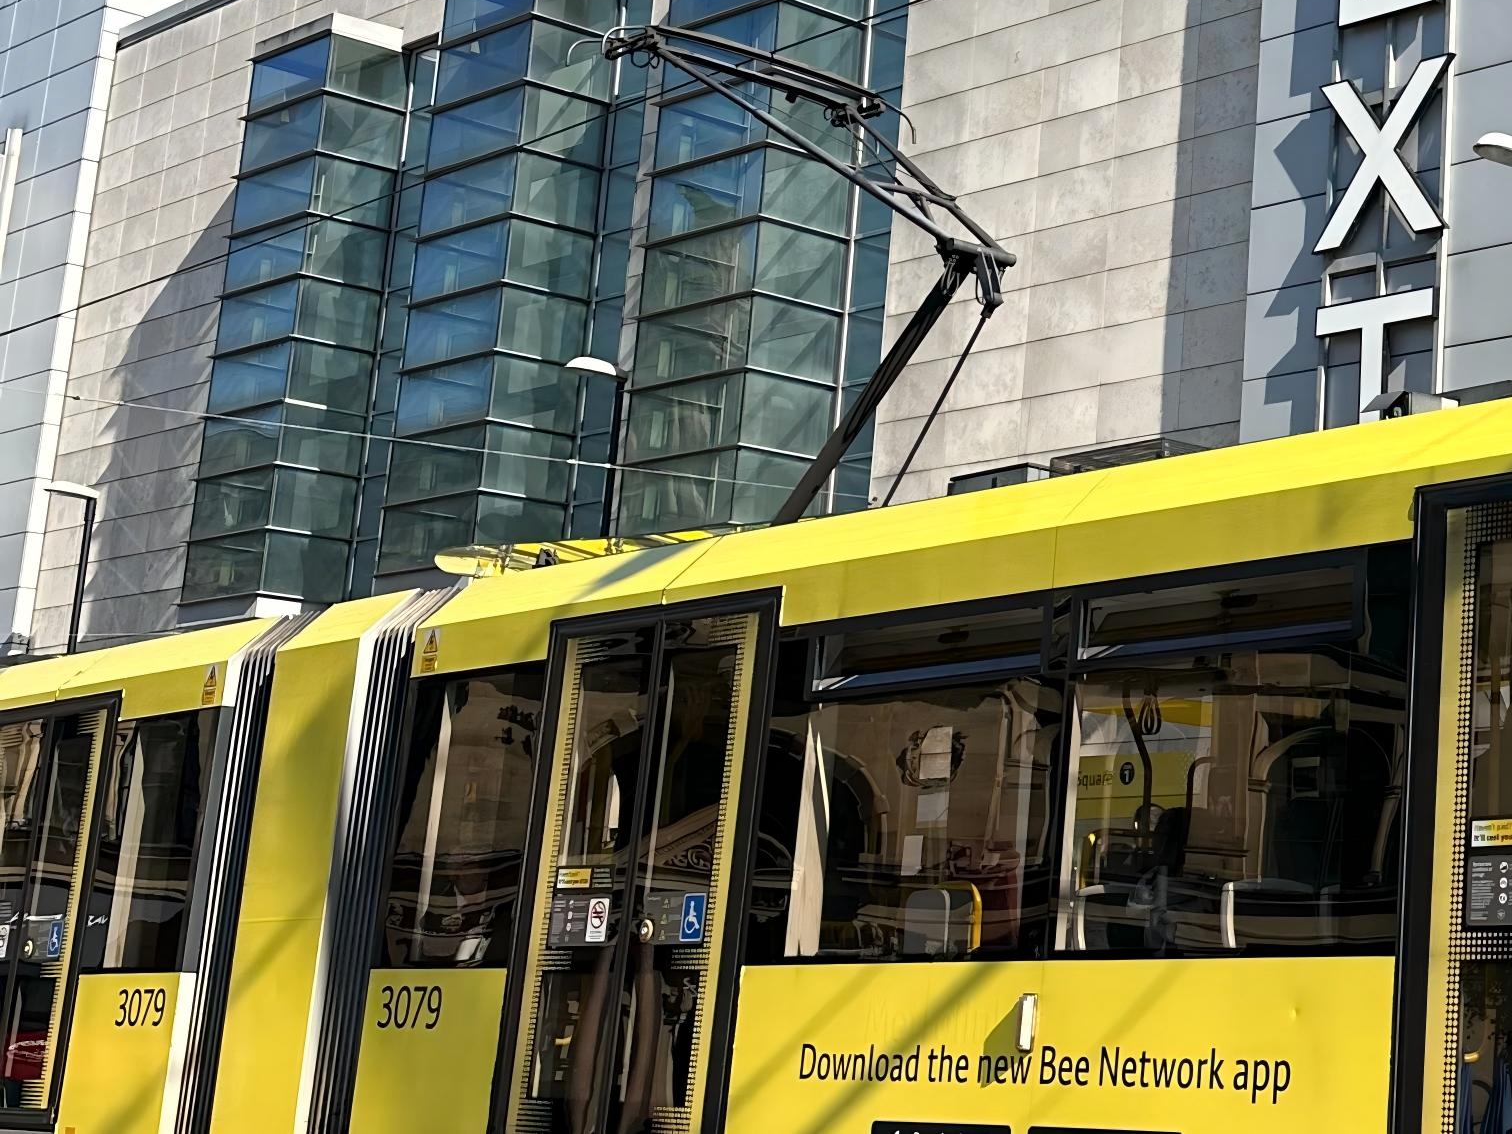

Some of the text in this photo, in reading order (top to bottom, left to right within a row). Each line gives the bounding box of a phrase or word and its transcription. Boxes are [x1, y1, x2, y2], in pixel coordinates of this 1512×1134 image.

[114, 988, 166, 1027] 3079
[376, 985, 443, 1030] 3079
[799, 1043, 1291, 1105] Download the new Bee Network app
